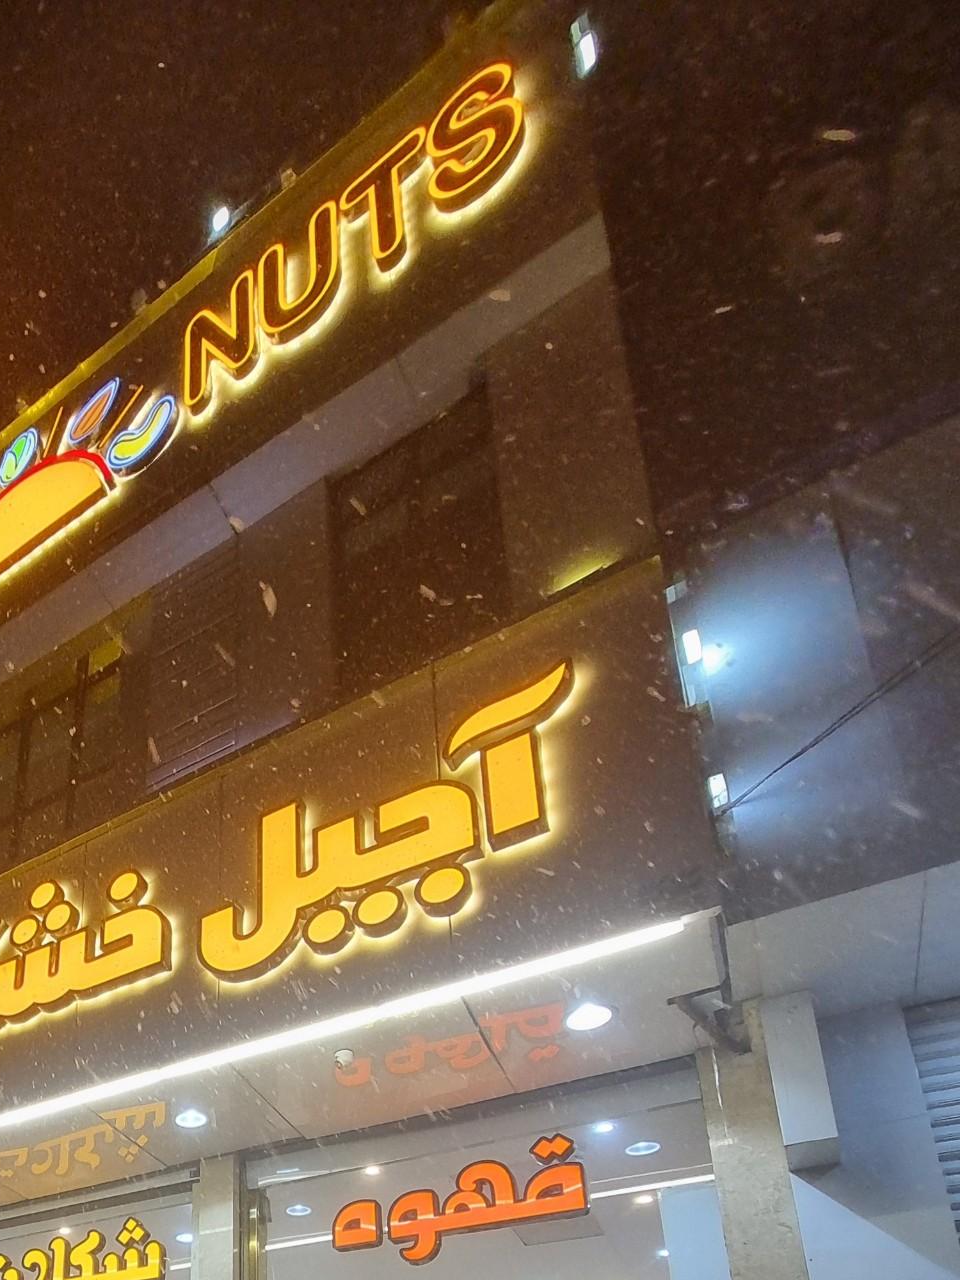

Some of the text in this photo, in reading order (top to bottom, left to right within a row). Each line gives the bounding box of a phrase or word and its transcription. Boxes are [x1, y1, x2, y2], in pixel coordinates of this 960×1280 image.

[183, 60, 526, 410] NUTS
[199, 659, 574, 978] آجیل
[332, 1133, 591, 1266] قهوه
